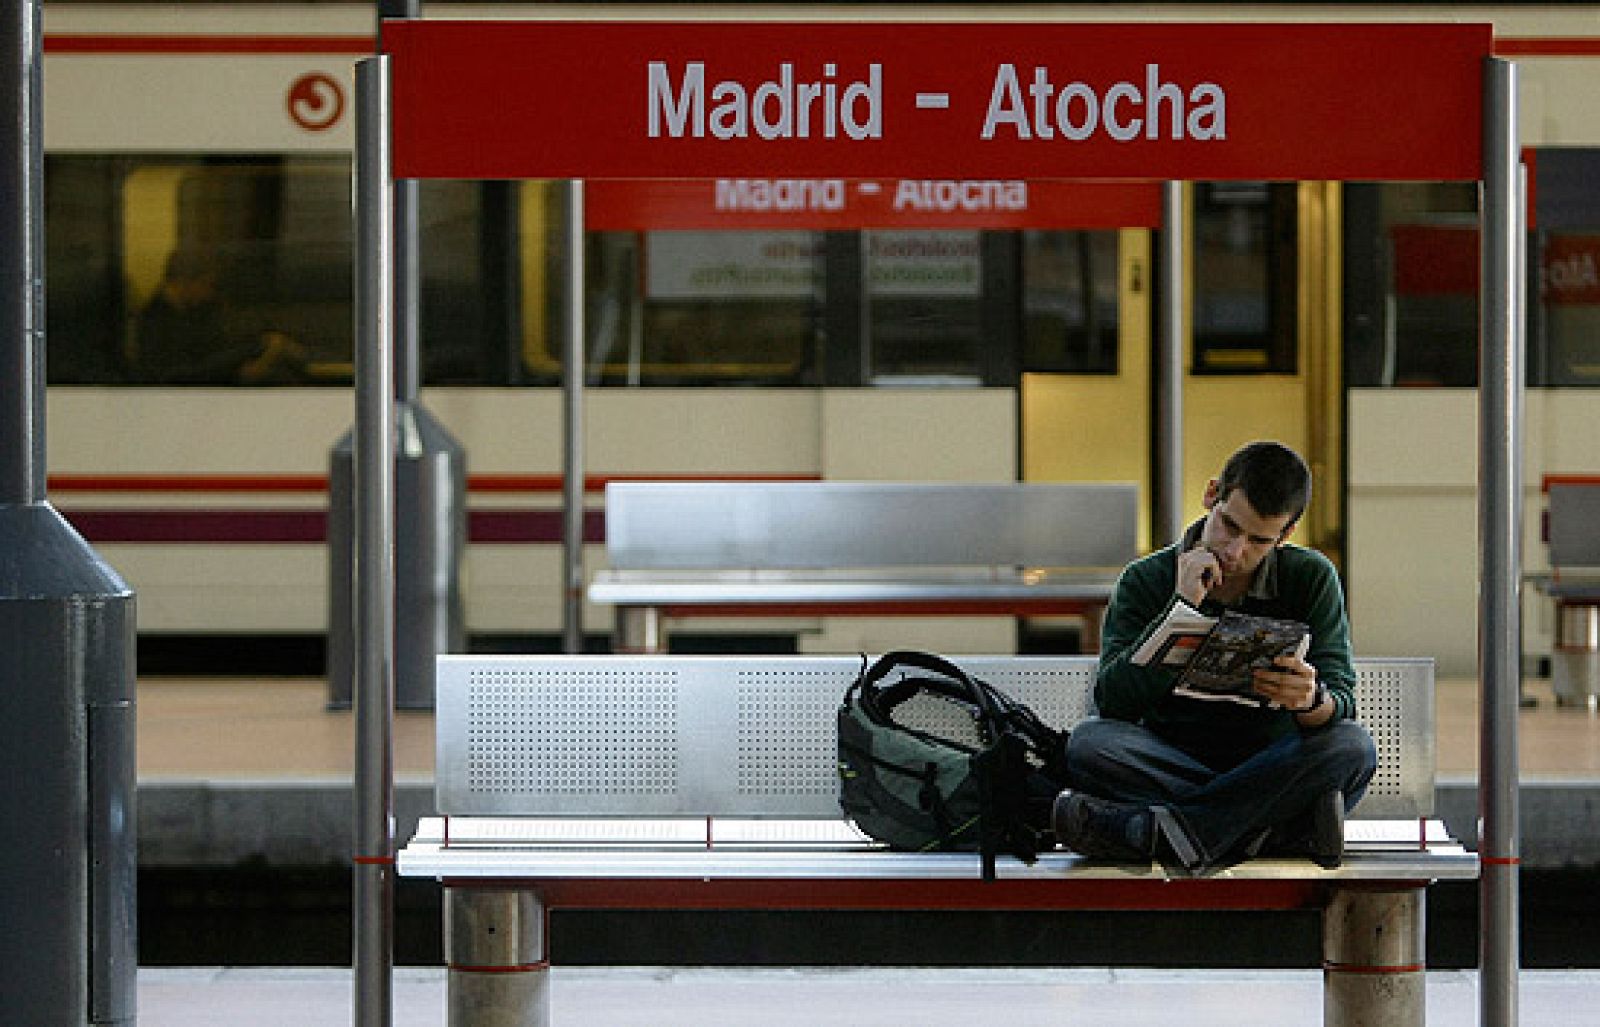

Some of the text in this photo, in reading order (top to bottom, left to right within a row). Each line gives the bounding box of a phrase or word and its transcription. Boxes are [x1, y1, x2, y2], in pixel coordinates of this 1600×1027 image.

[647, 61, 1227, 140] Madrid - Atocha
